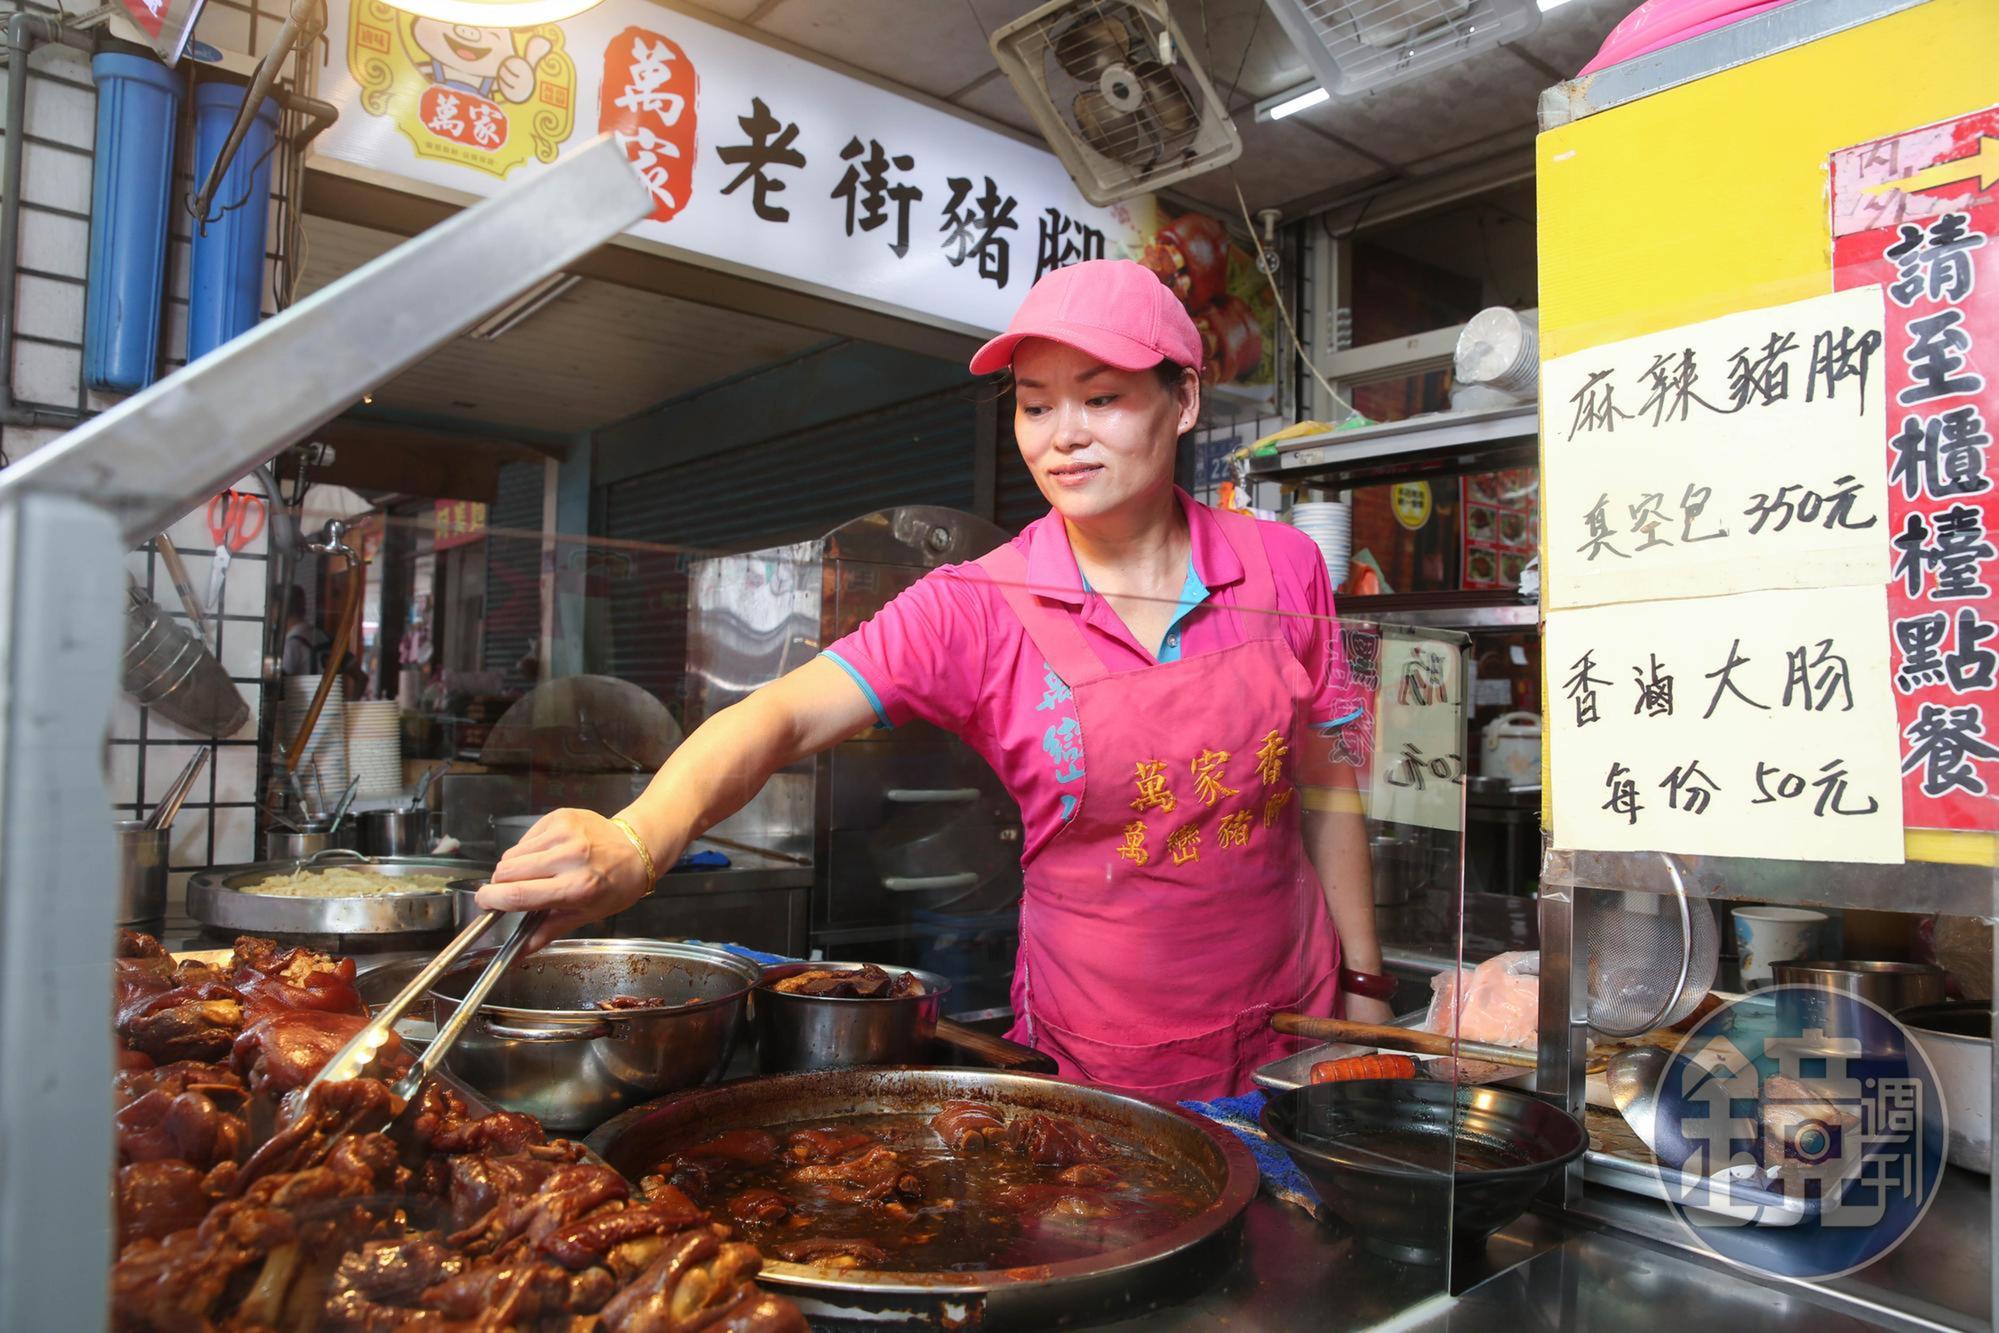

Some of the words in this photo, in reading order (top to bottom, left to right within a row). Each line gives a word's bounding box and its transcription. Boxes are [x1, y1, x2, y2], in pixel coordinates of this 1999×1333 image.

[428, 93, 505, 145] 萬家
[1886, 212, 1999, 796] 請至櫃檯點餐
[1129, 729, 1288, 814] 萬家香
[1601, 760, 1722, 825] 每份
[1751, 759, 1878, 817] 50元
